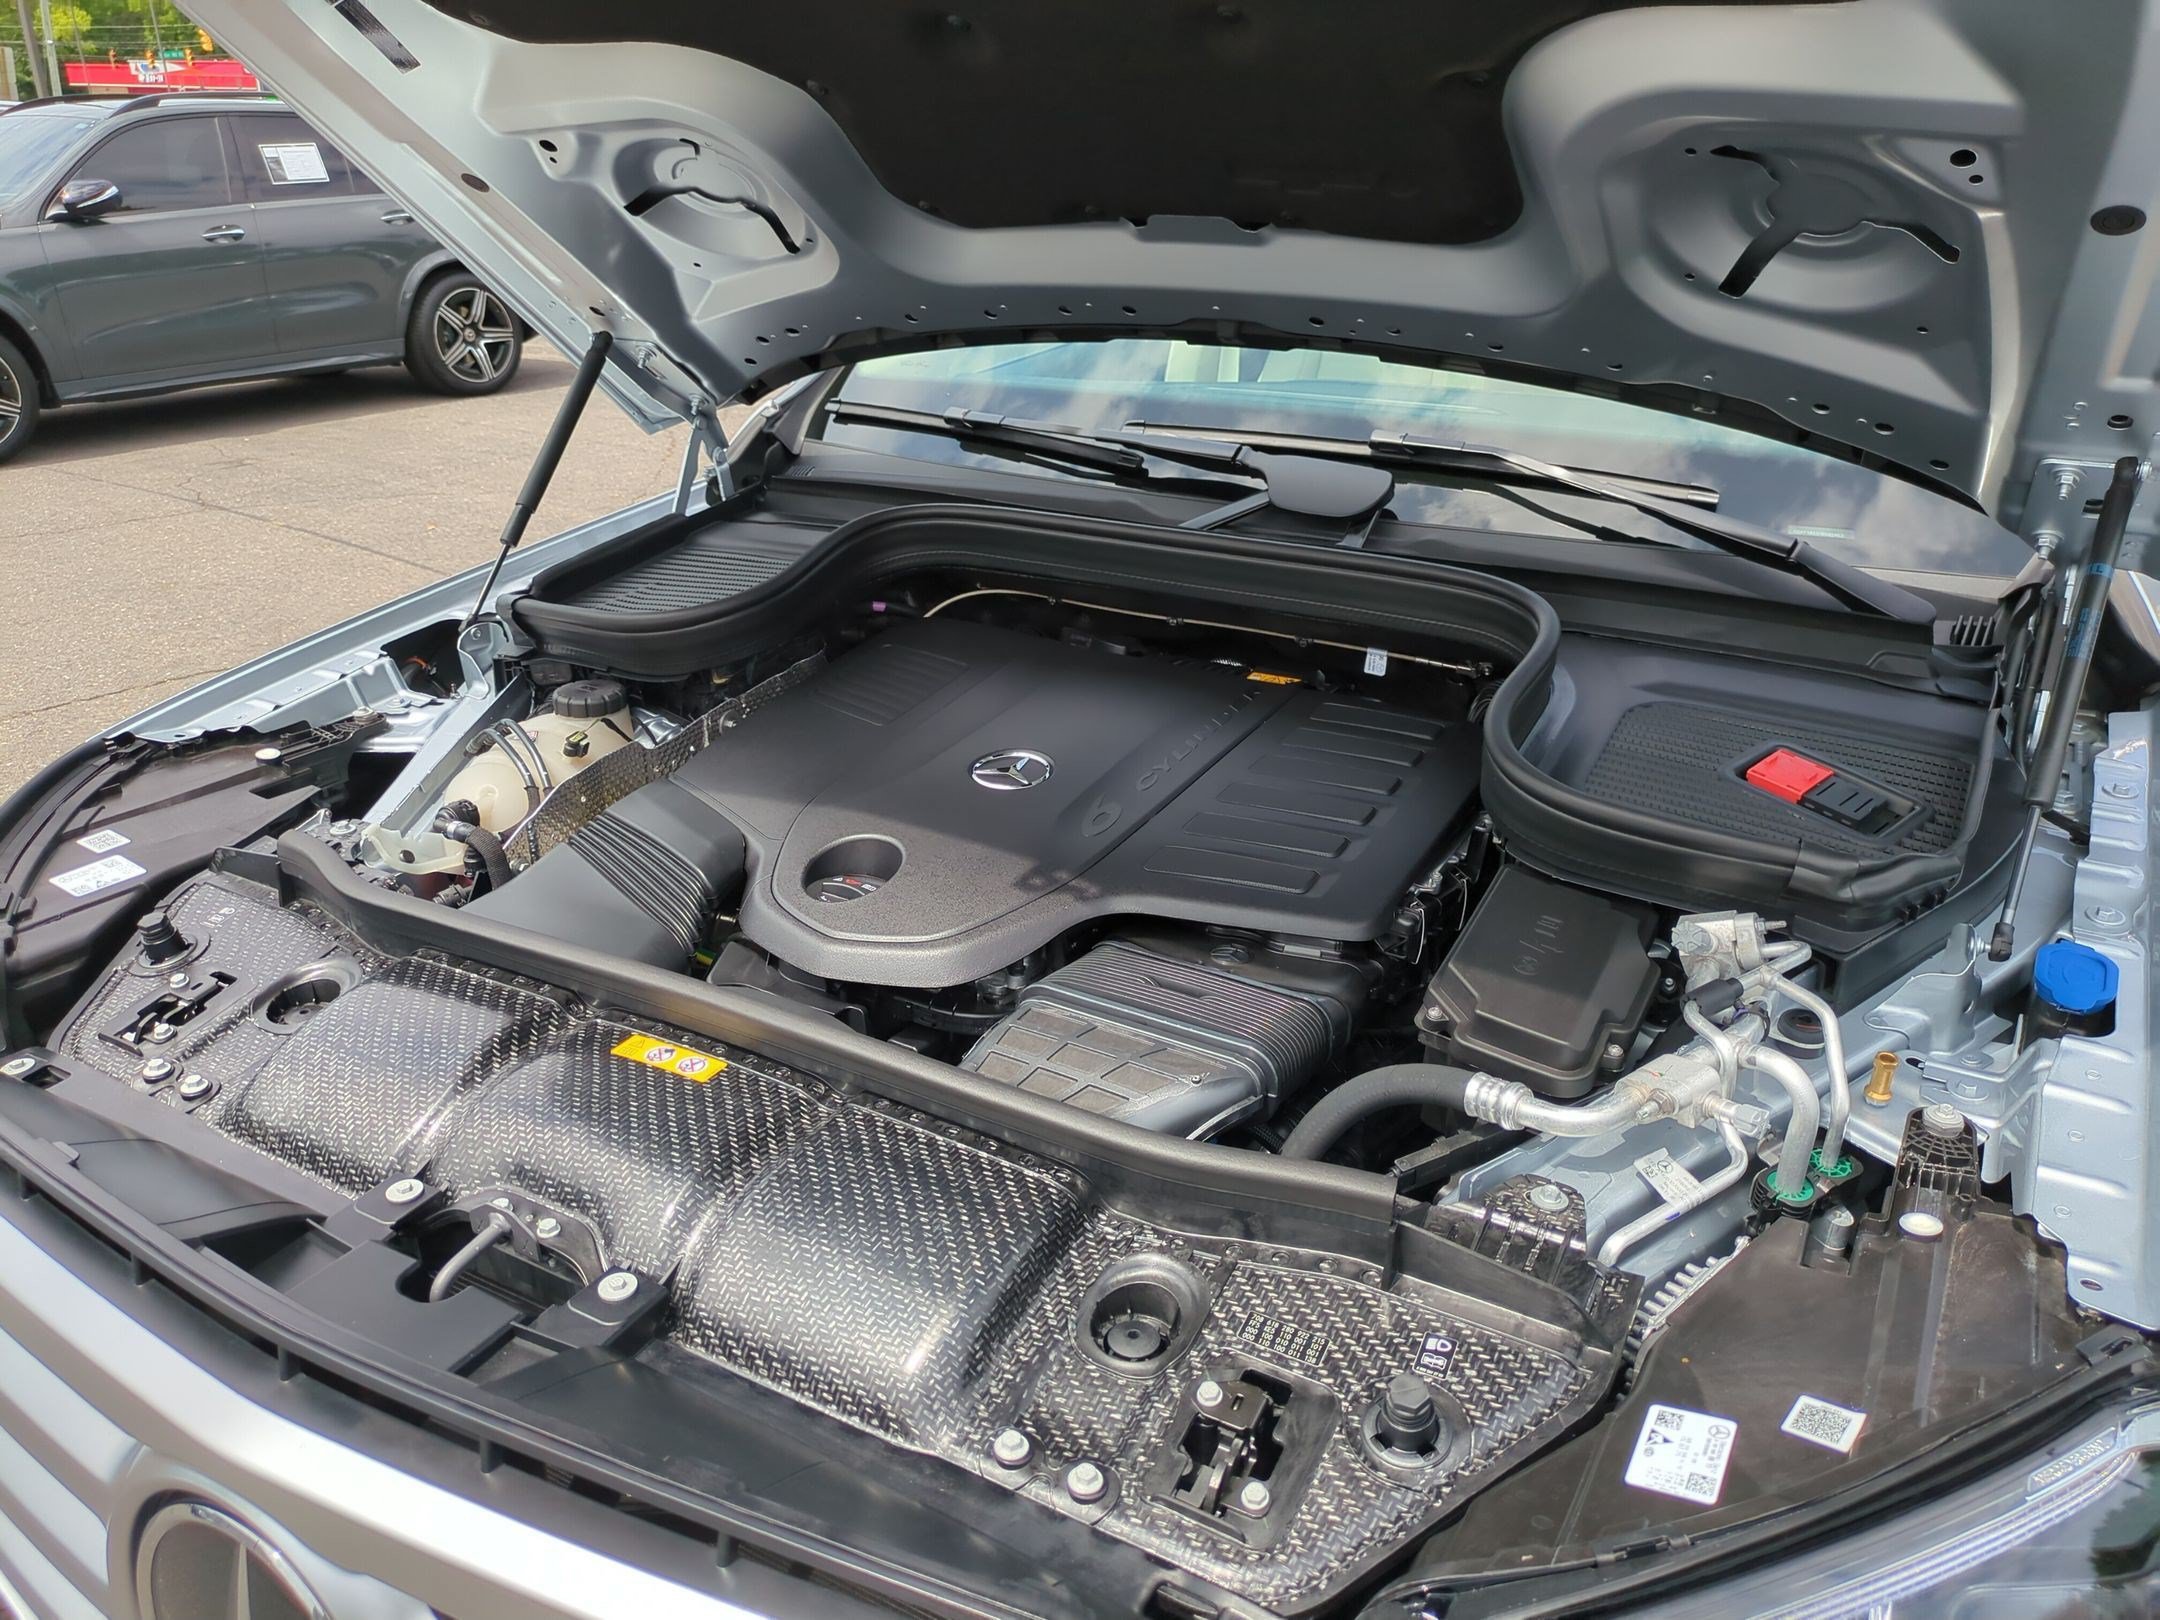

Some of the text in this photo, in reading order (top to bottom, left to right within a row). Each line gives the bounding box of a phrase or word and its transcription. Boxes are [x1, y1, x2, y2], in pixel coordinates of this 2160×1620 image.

[1081, 792, 1124, 838] 6
[1242, 1333, 1255, 1341] 000
[1258, 1339, 1270, 1347] 110
[1274, 1344, 1285, 1352] 100
[1288, 1349, 1300, 1358] 011
[1245, 1327, 1258, 1335] 000
[1276, 1338, 1288, 1346] 010
[1291, 1343, 1303, 1351] 011
[1307, 1349, 1319, 1358] 001
[1280, 1331, 1291, 1340] 110
[1294, 1337, 1306, 1345] 001
[1310, 1342, 1322, 1351] 101
[1312, 1336, 1325, 1345] 215
